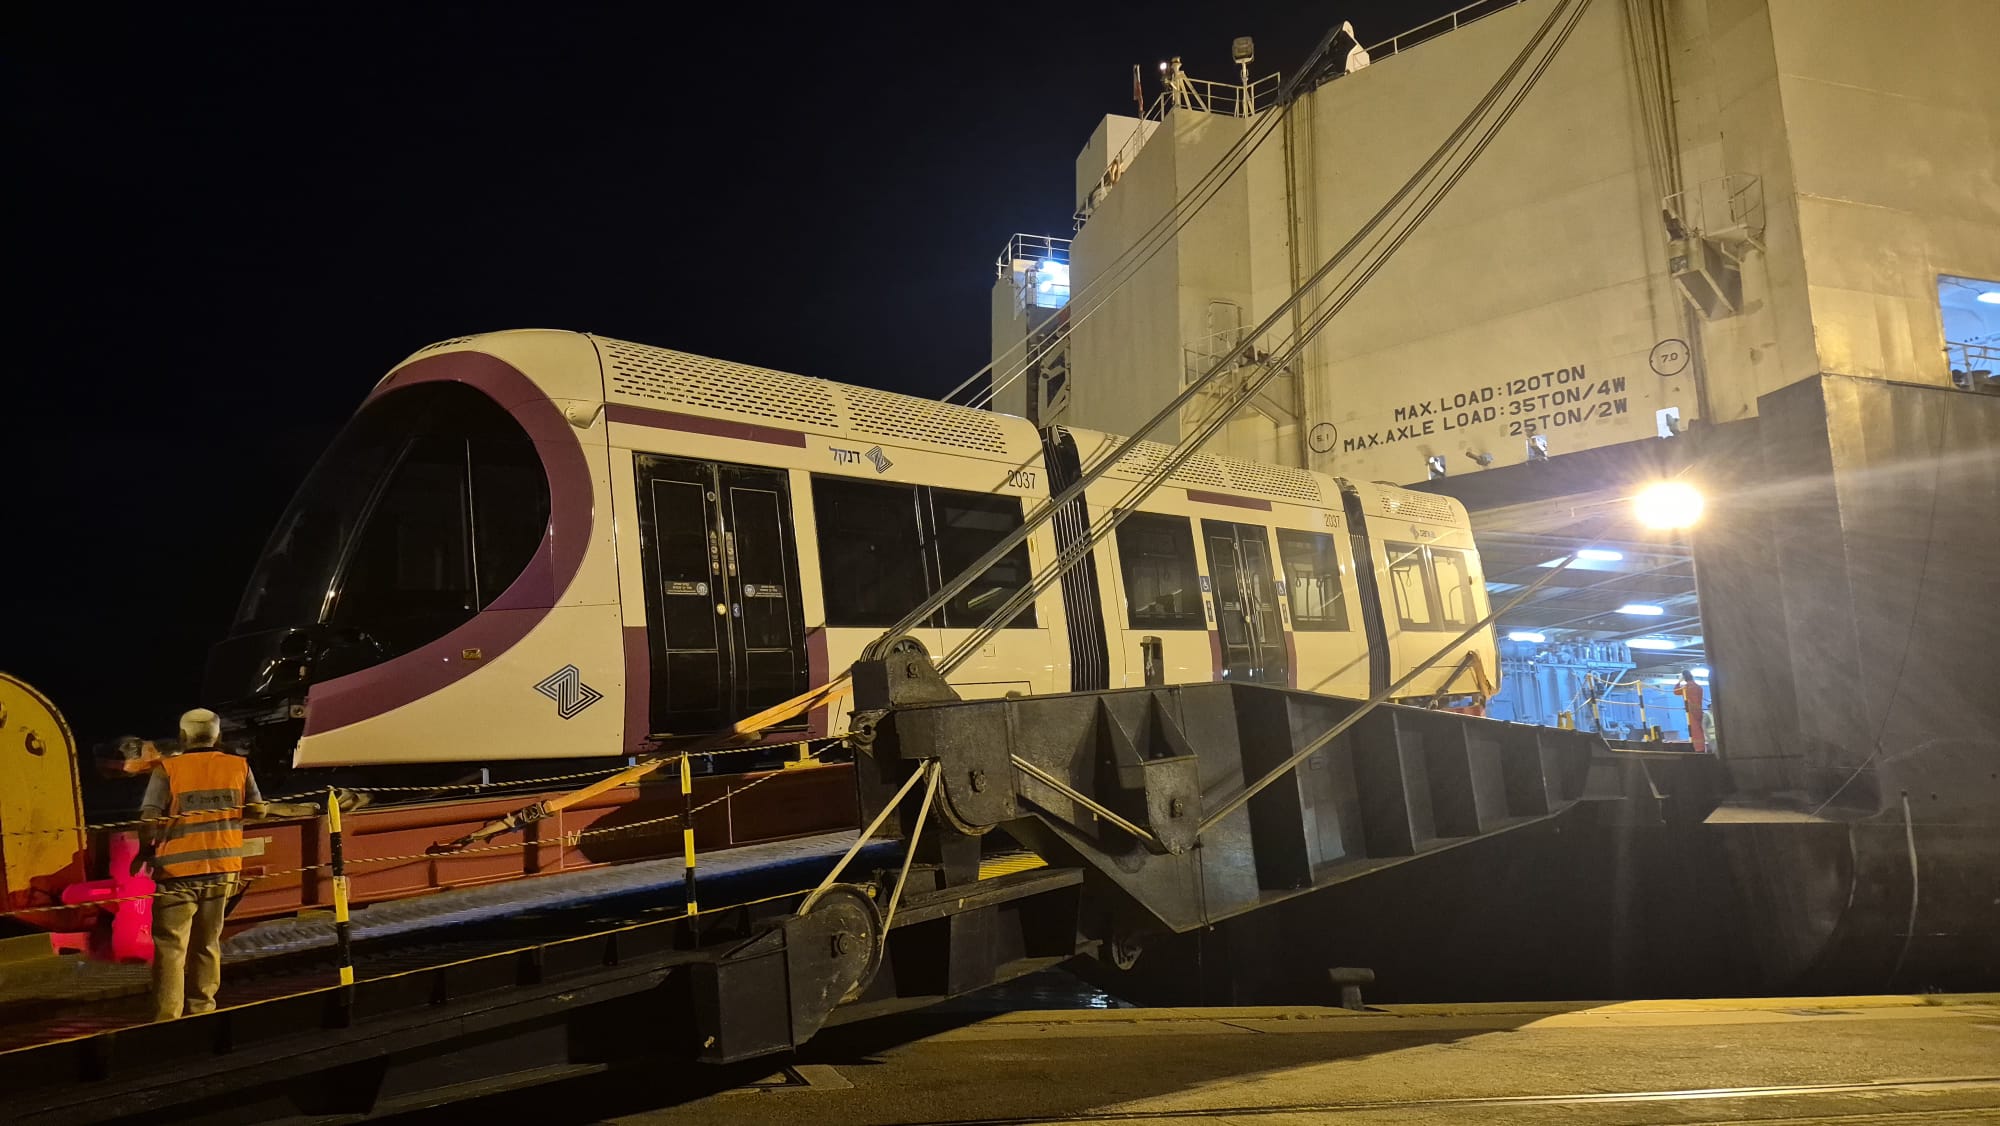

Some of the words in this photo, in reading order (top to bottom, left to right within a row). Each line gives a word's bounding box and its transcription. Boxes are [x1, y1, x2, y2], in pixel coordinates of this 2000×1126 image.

[1509, 397, 1627, 437] 25TON/2W
[828, 445, 860, 466] דנקל
[1007, 469, 1036, 489] 2037
